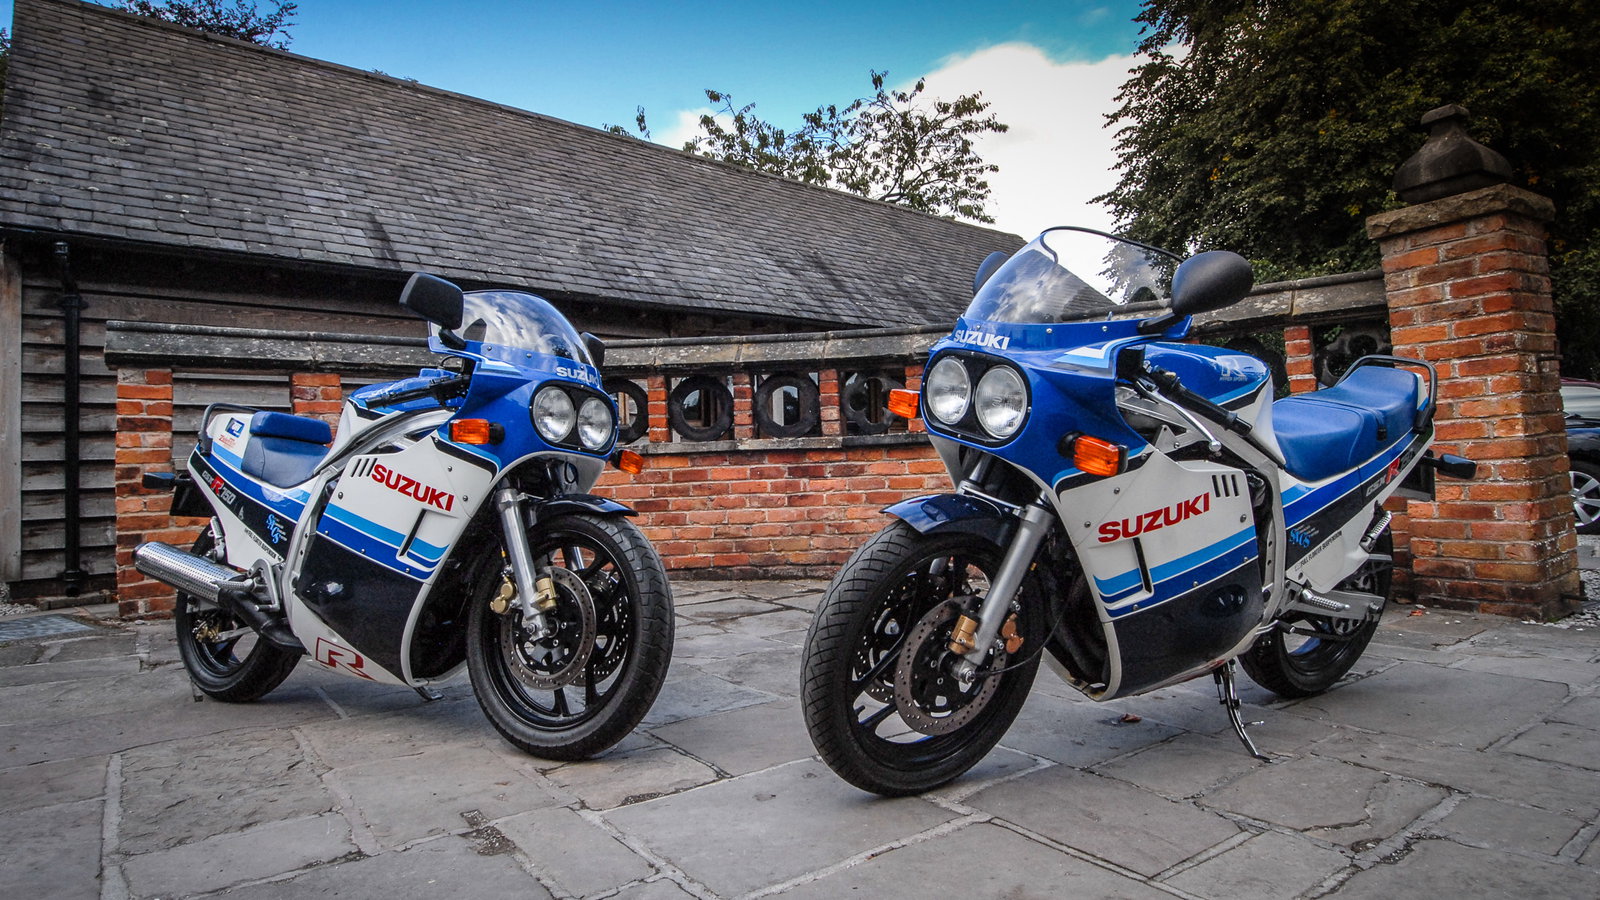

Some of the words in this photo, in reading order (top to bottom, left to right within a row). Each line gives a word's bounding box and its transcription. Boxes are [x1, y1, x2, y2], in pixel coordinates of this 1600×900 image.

[954, 329, 1010, 350] SUZUKI
[371, 463, 455, 512] SUZUKI
[1098, 492, 1210, 543] SUZUKI
